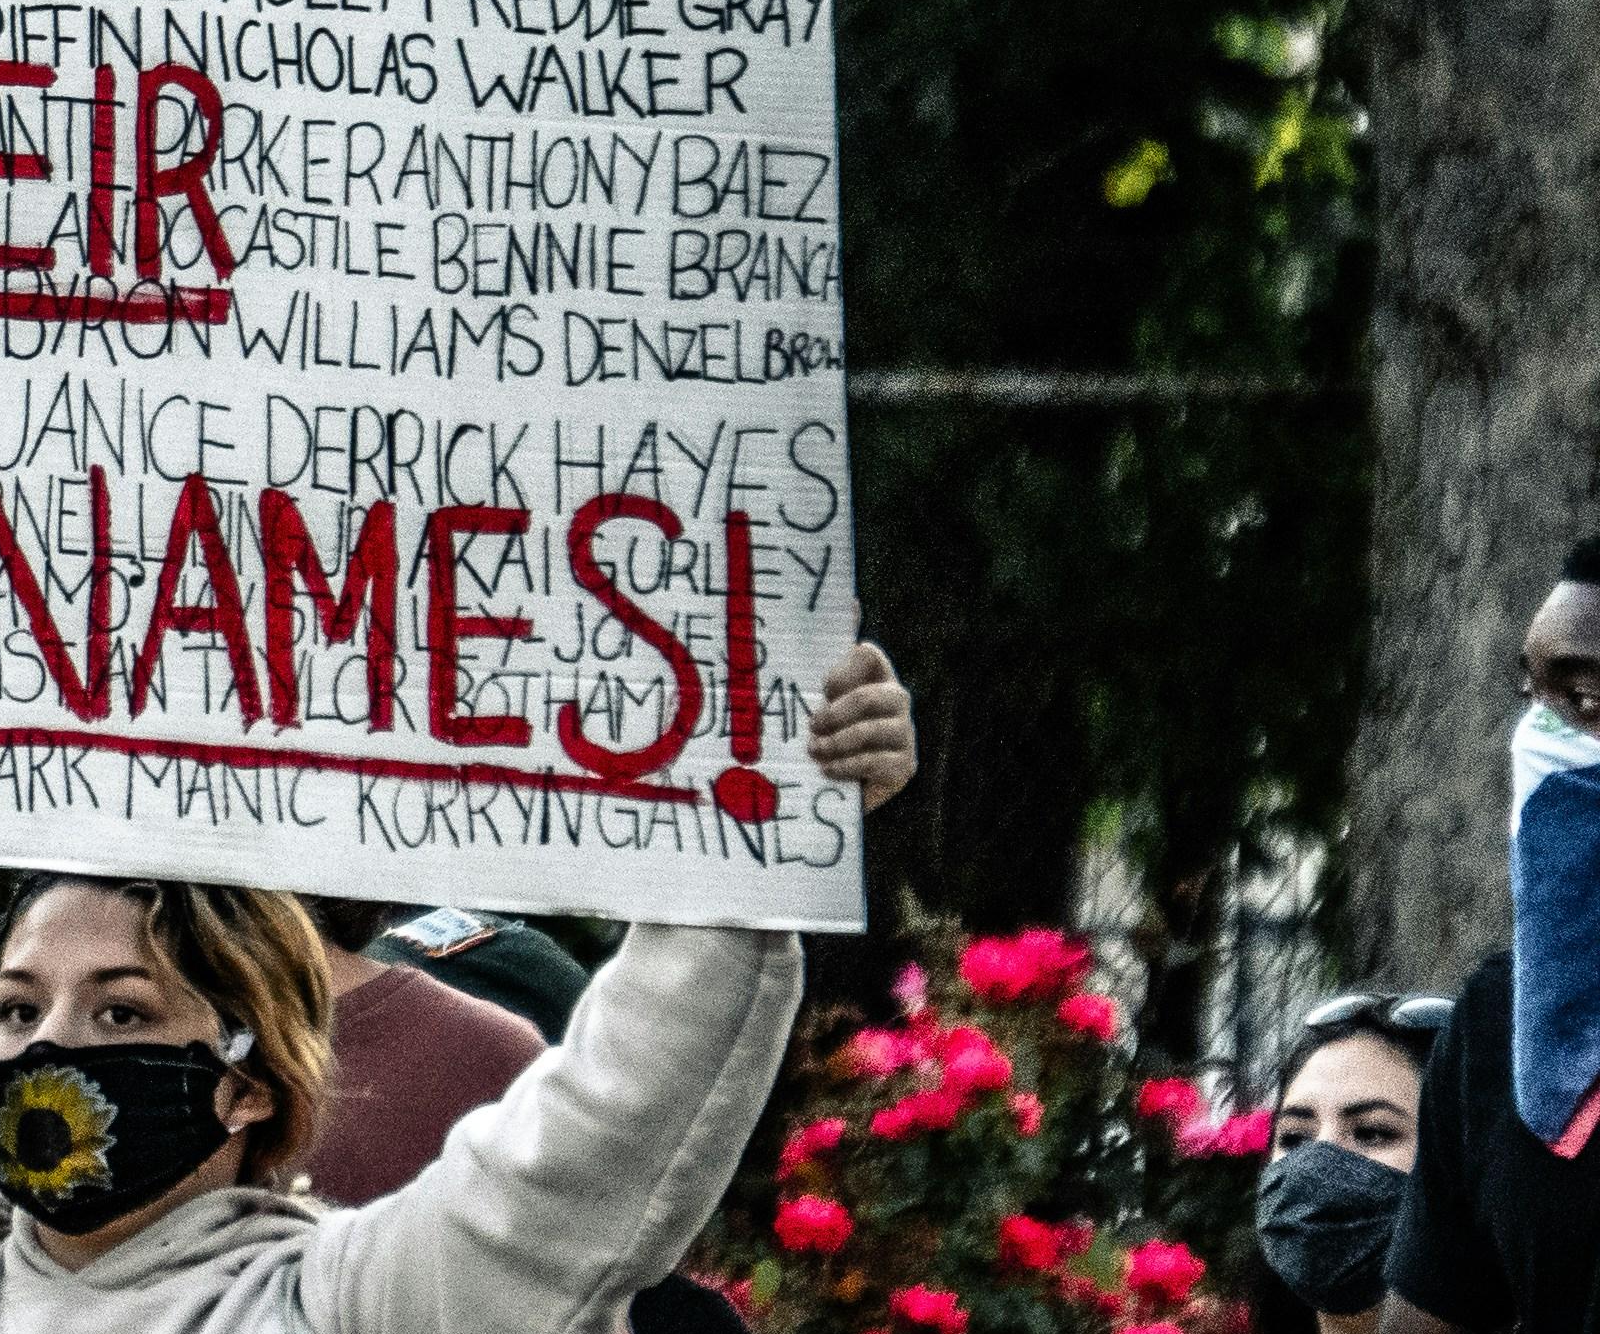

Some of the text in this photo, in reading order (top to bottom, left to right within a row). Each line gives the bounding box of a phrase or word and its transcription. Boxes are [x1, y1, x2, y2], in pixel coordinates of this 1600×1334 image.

[165, 5, 439, 105] NICHOLAS
[457, 37, 750, 118] WALKER
[148, 94, 386, 209] PARKER
[393, 122, 663, 216] ANTHONY
[671, 134, 832, 223] BAEZ
[212, 204, 416, 279] CASTILE
[431, 211, 647, 299] BENNIE
[229, 284, 545, 380] WILLIAMS
[563, 309, 765, 387] DENZEL
[265, 393, 531, 512] DERRICK
[554, 418, 840, 534] HAYES
[408, 512, 551, 598] AKAI
